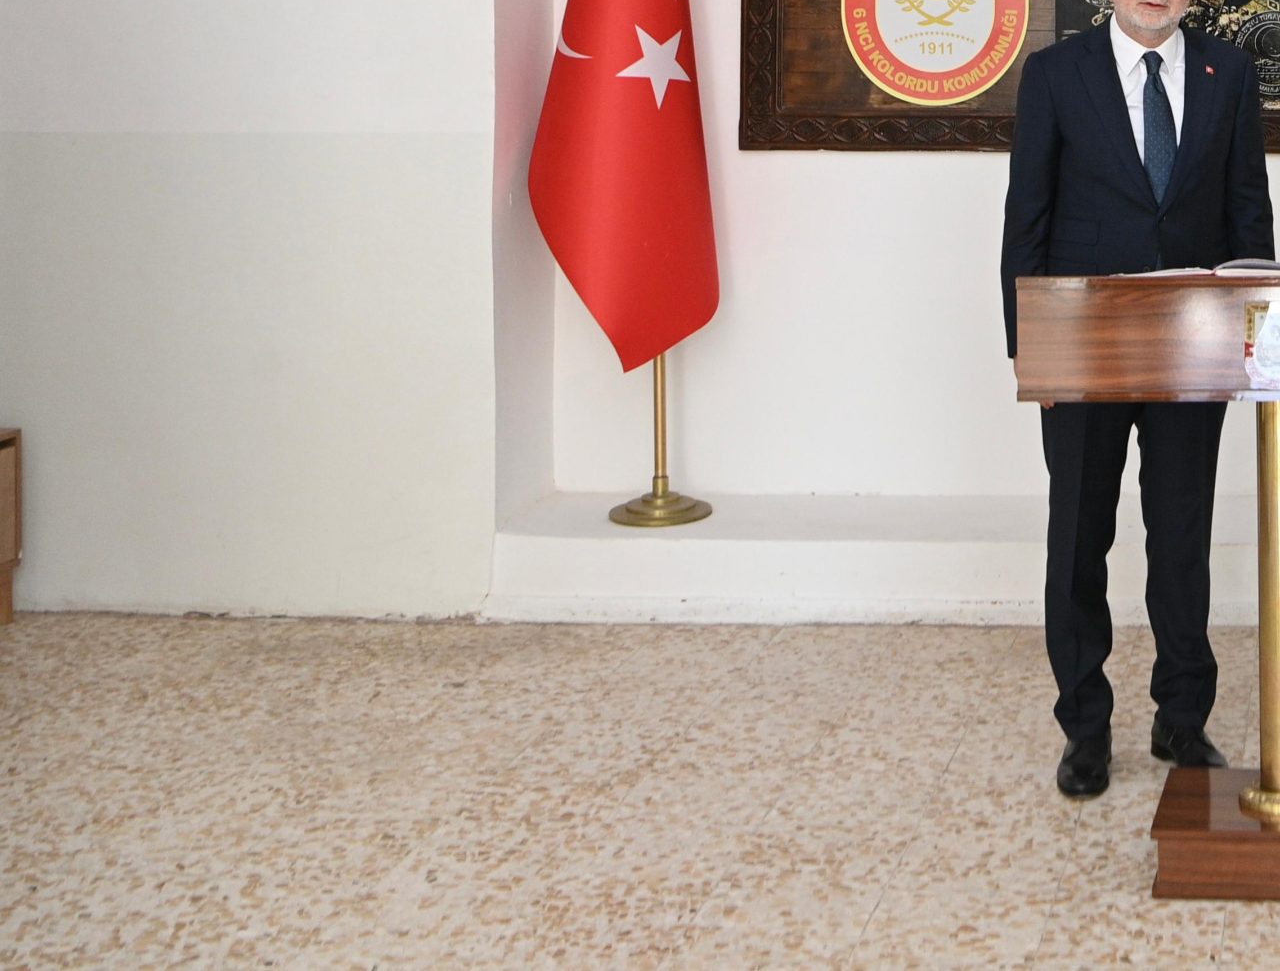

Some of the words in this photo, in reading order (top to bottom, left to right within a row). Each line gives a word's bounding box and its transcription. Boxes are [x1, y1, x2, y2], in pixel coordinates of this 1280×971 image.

[853, 7, 867, 19] 6
[868, 49, 940, 93] KOLORDU
[943, 8, 1018, 93] KOMUTANLIĞI
[919, 42, 954, 55] 1911
